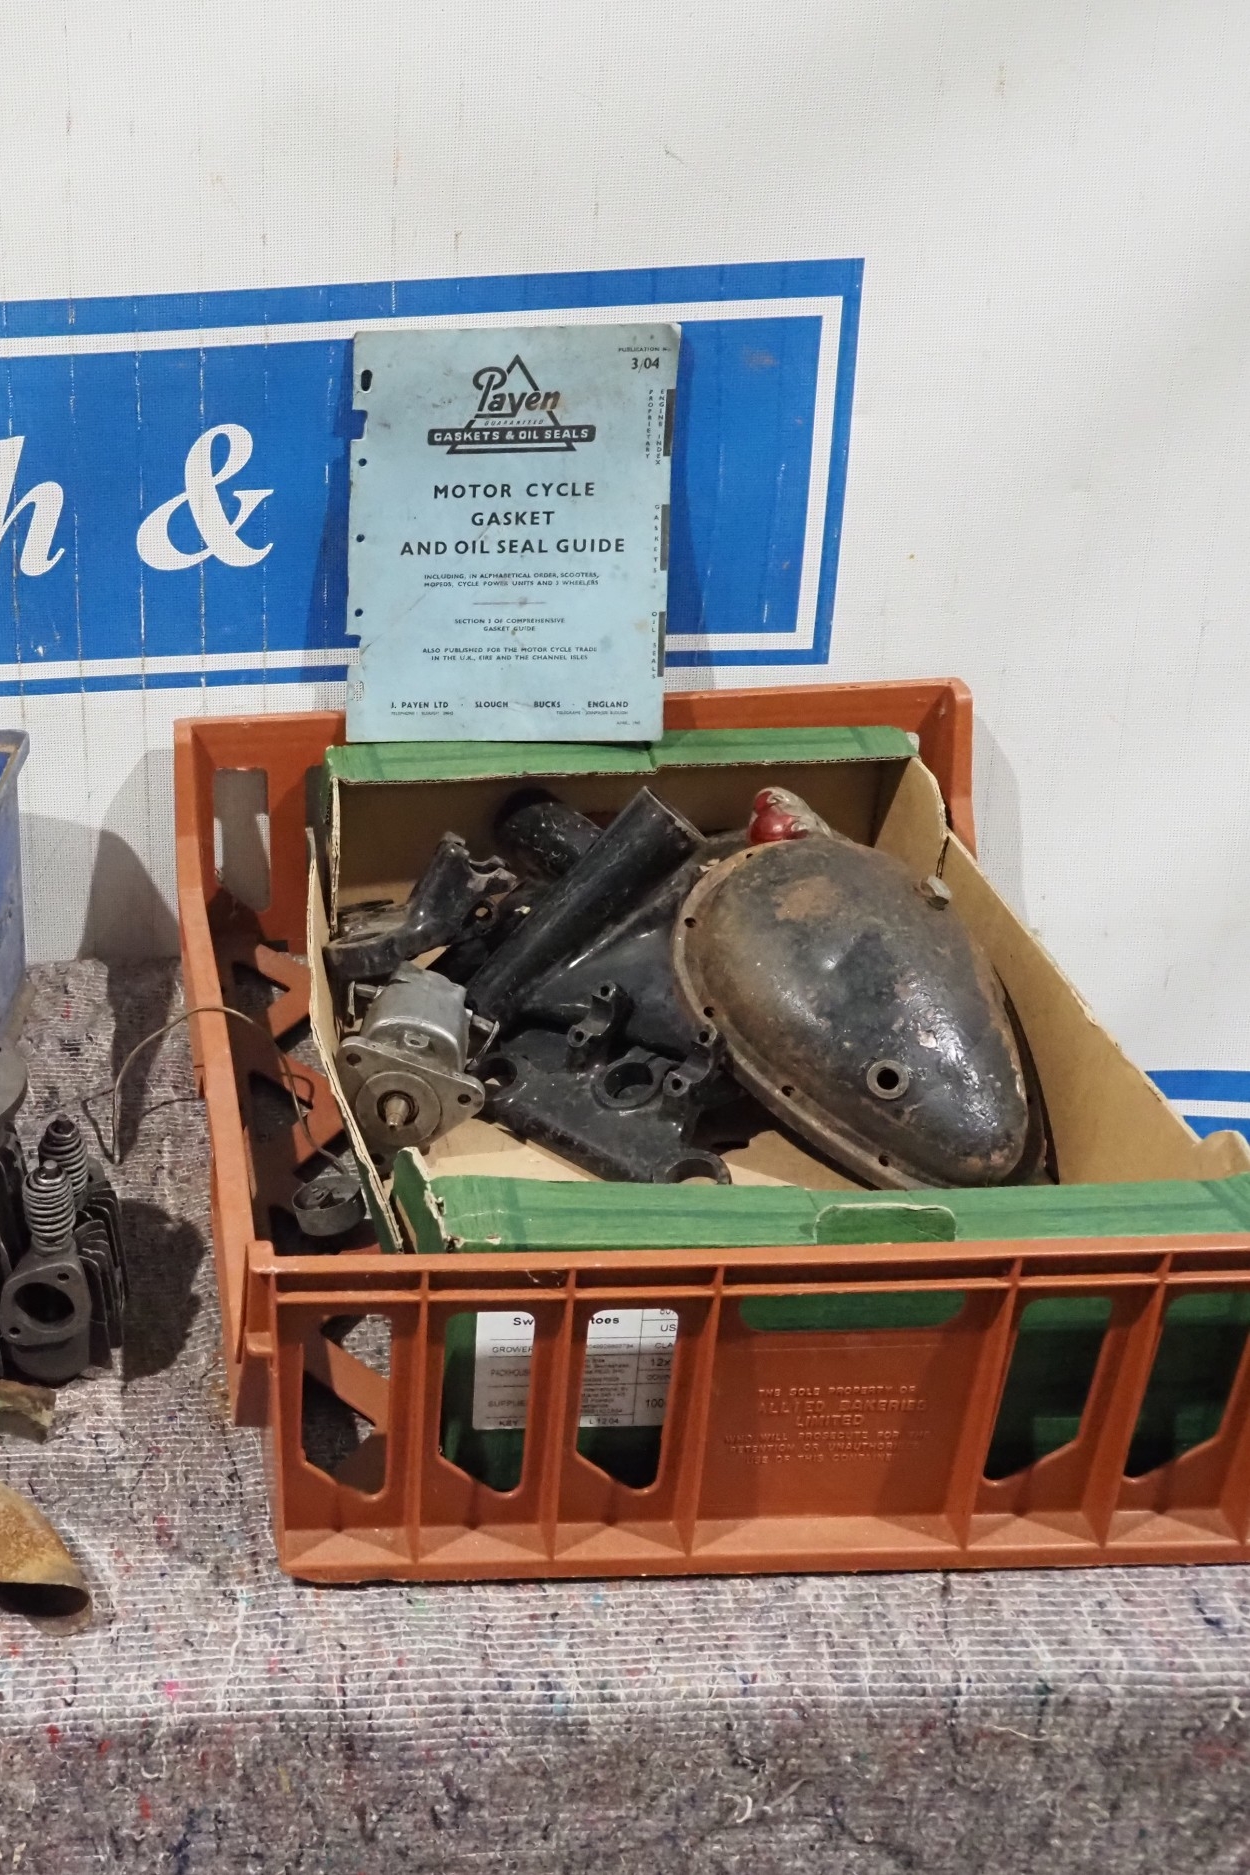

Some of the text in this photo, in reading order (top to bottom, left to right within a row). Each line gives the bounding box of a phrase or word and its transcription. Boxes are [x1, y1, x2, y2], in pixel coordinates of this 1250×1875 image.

[631, 356, 660, 373] 3/04
[472, 366, 561, 419] Payen
[645, 389, 654, 460] PROPRIETARY
[433, 428, 590, 443] GASKETS & OIL SEALS
[655, 433, 663, 466] INDEX
[135, 423, 275, 571] &
[433, 482, 595, 499] MOTOR CYCLE
[471, 511, 555, 527] GASKET
[400, 538, 625, 556] AND OIL SEAL GUIDE
[560, 571, 600, 579] SCOOTERS,
[390, 700, 629, 709] J. PAYEN LTD SLOUGH BUCKS ENGLAND
[513, 1316, 620, 1326] Sw toes
[660, 1324, 677, 1332] US
[651, 1358, 671, 1367] 12x
[789, 1387, 821, 1396] SOLE
[828, 1385, 894, 1396] PROPERTY
[899, 1385, 916, 1395] OF
[488, 1400, 527, 1408] SUPPLIE
[757, 1399, 929, 1414] ALLIED BAKERIES
[796, 1413, 865, 1428] LIMITED
